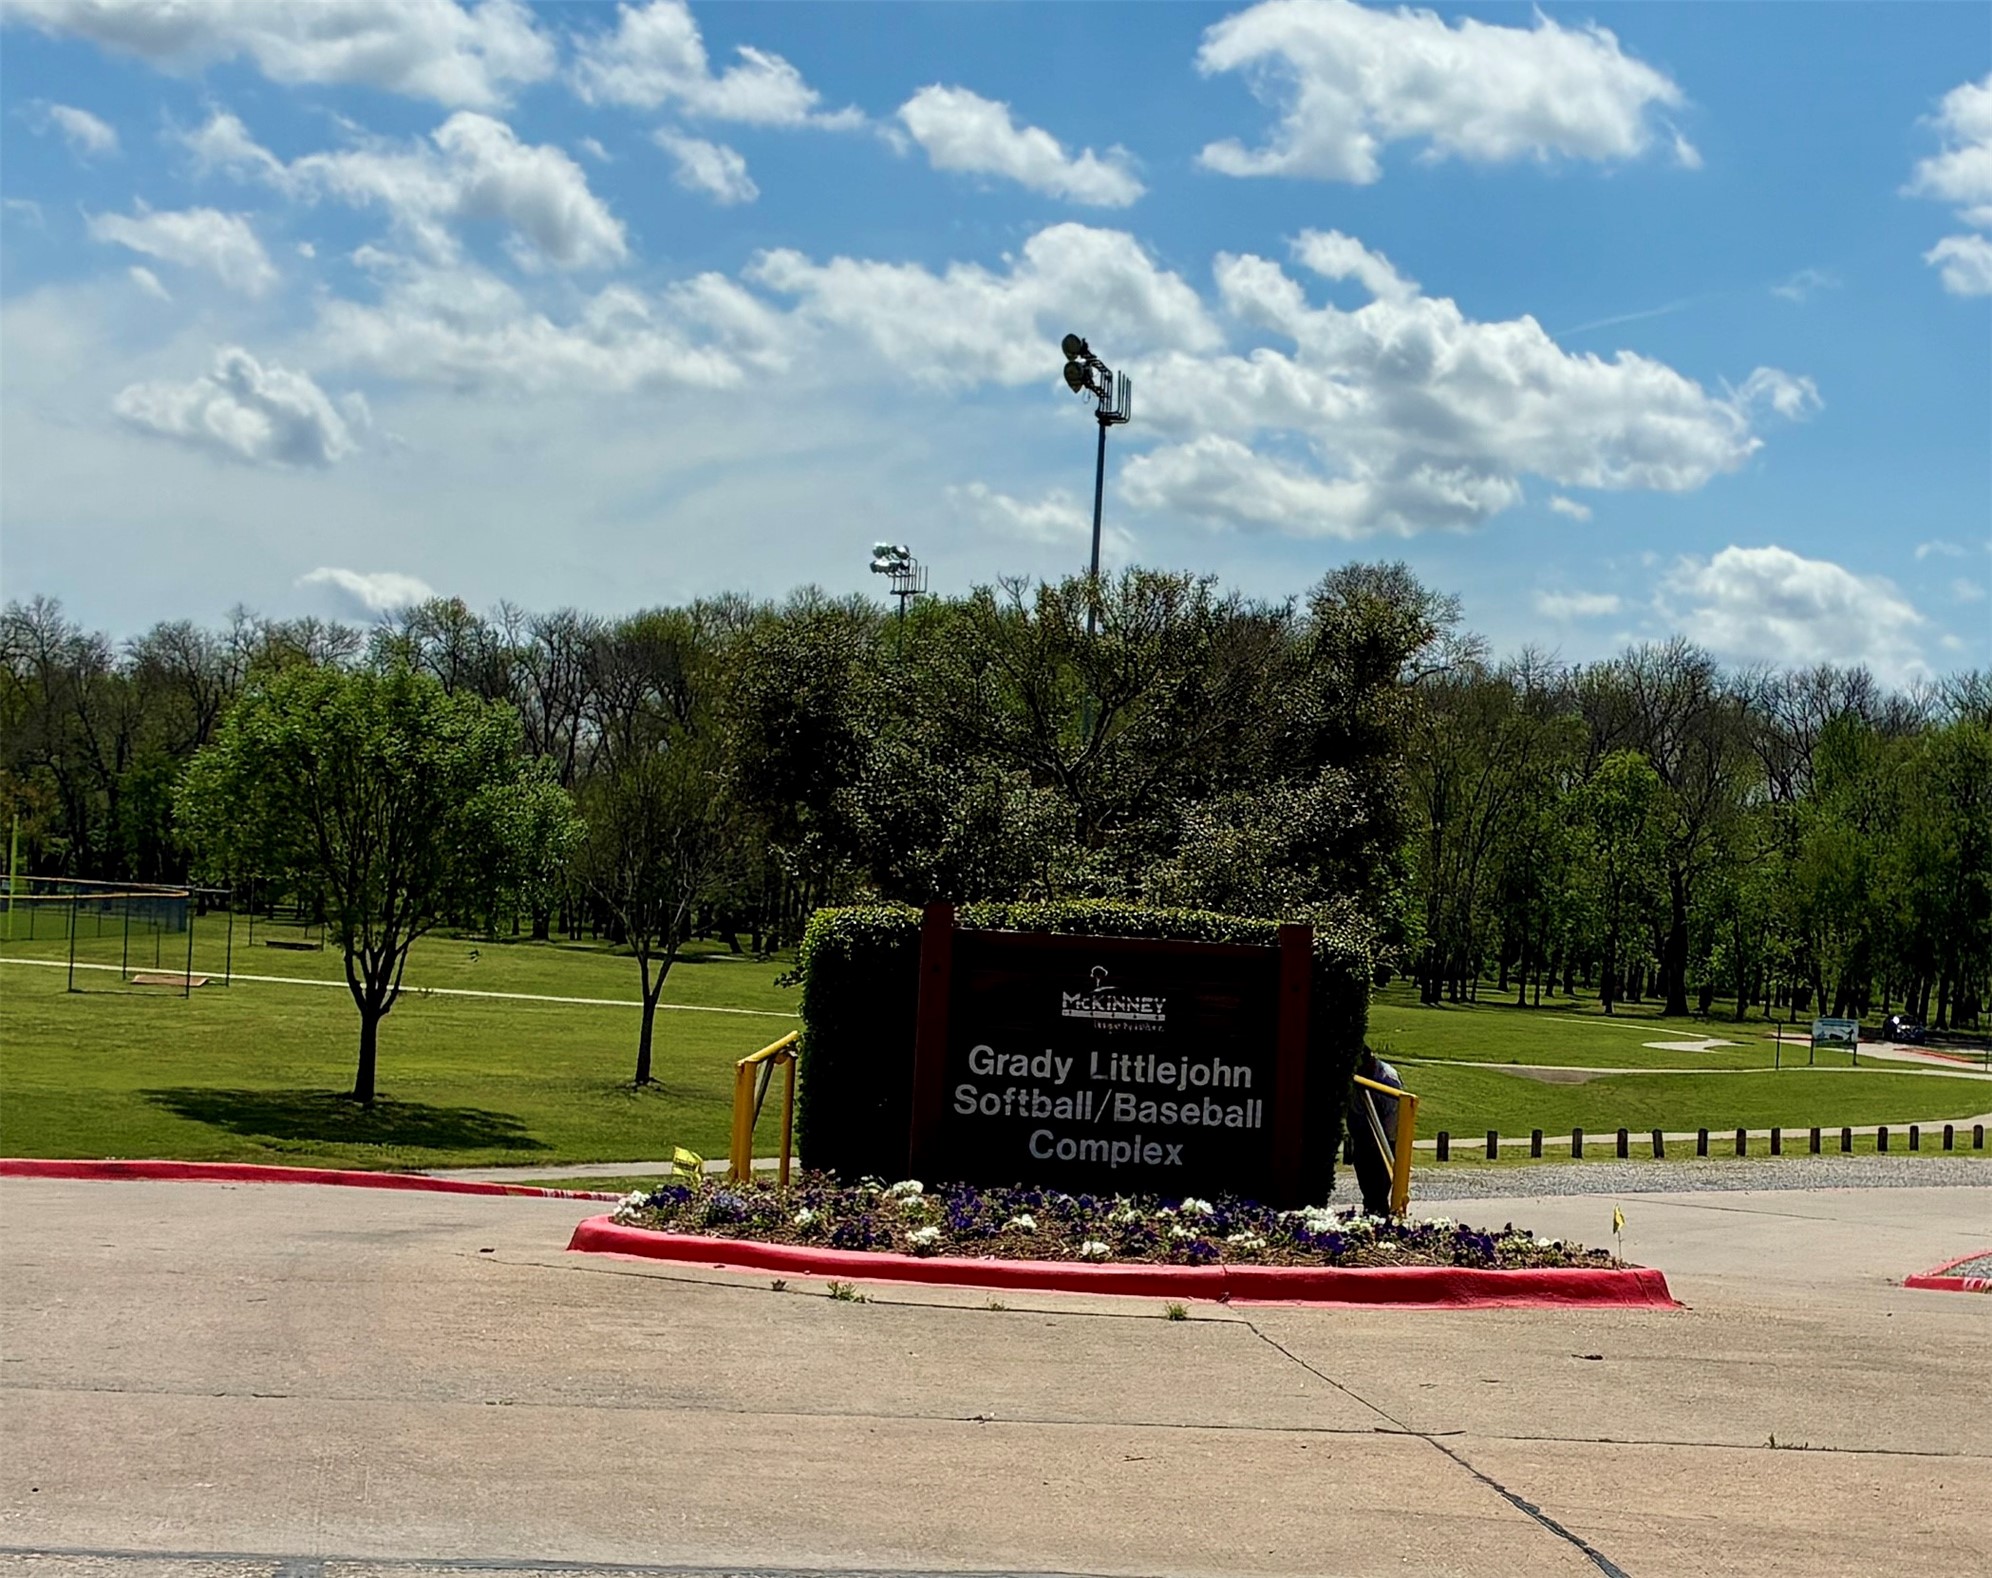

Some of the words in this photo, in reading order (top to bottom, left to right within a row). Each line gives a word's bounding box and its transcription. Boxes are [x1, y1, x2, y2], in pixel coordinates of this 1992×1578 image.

[968, 1044, 1074, 1085] Grady
[1090, 1051, 1252, 1092] Littlejohn
[953, 1084, 1263, 1128] Softball/Baseball
[1029, 1129, 1184, 1168] Complex
